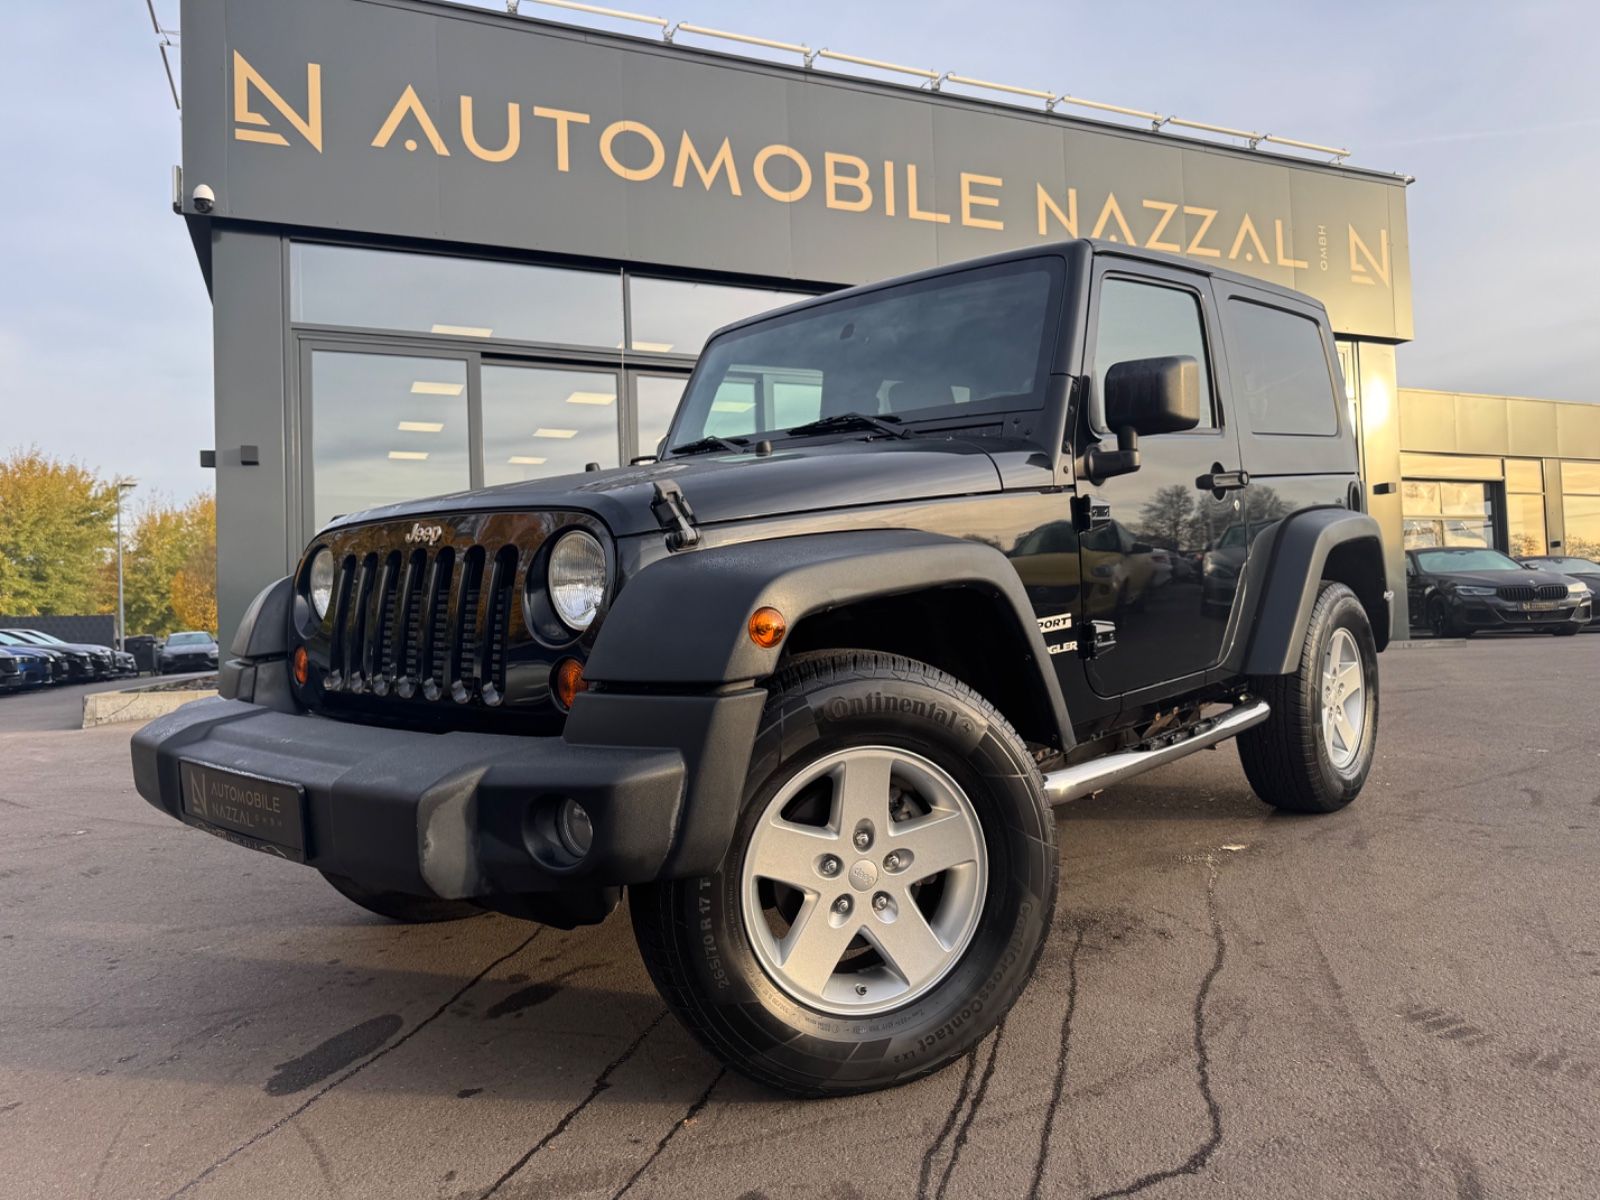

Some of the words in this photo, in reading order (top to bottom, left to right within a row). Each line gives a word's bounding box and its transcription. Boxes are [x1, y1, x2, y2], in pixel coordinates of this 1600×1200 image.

[371, 84, 1004, 231] AUTOMOBILE
[1036, 182, 1309, 268] NAZZAL
[405, 523, 442, 546] Jeep
[1037, 618, 1067, 630] PORT
[1048, 641, 1078, 654] GLER
[823, 691, 957, 728] Continental
[211, 783, 281, 814] AUTOMOBILE
[212, 804, 255, 828] NAZZAL
